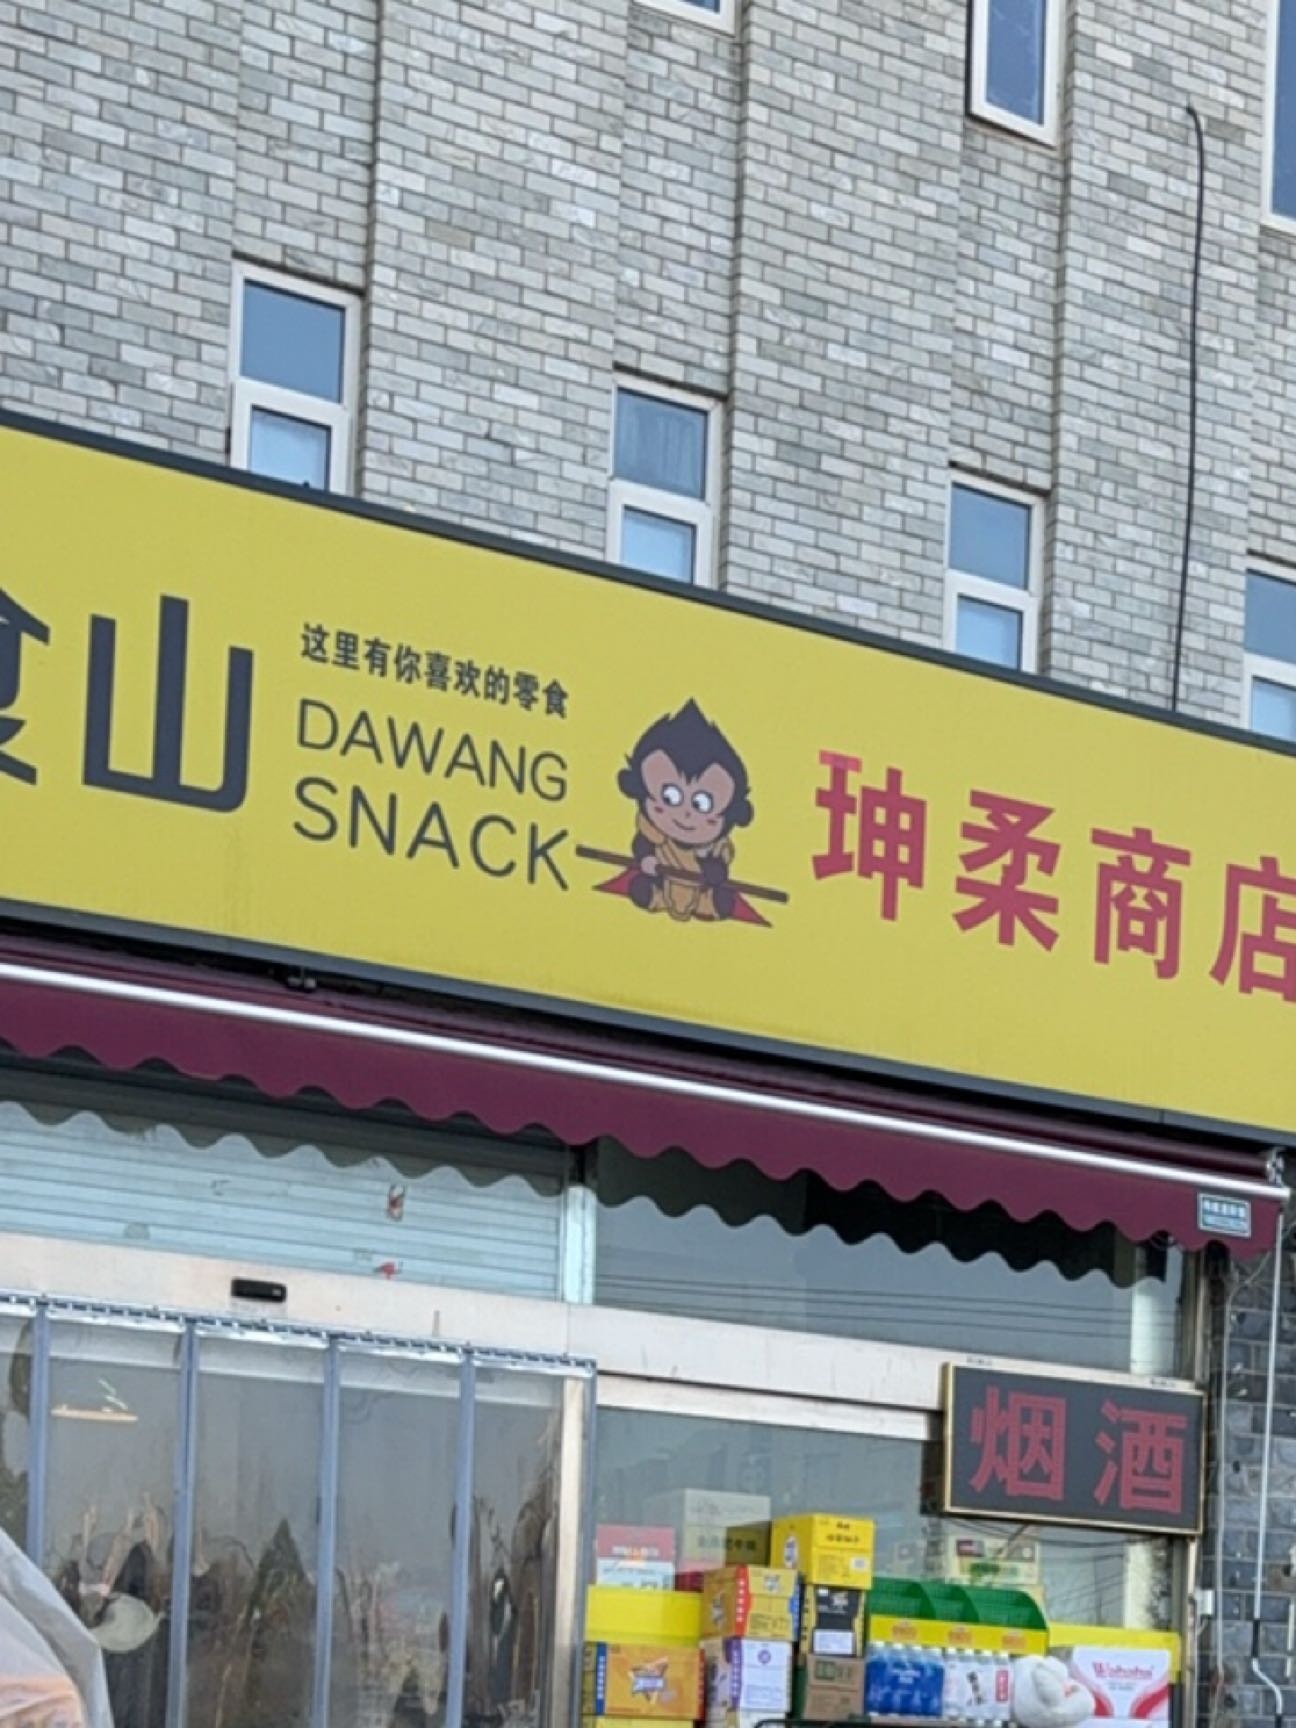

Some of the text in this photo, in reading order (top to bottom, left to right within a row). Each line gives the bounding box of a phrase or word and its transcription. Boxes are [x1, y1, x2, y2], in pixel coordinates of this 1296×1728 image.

[301, 622, 569, 718] 这里有你喜欢的零食
[297, 698, 568, 801] DAWANG
[293, 777, 570, 891] SNACK
[969, 1385, 1189, 1514] 烟酒
